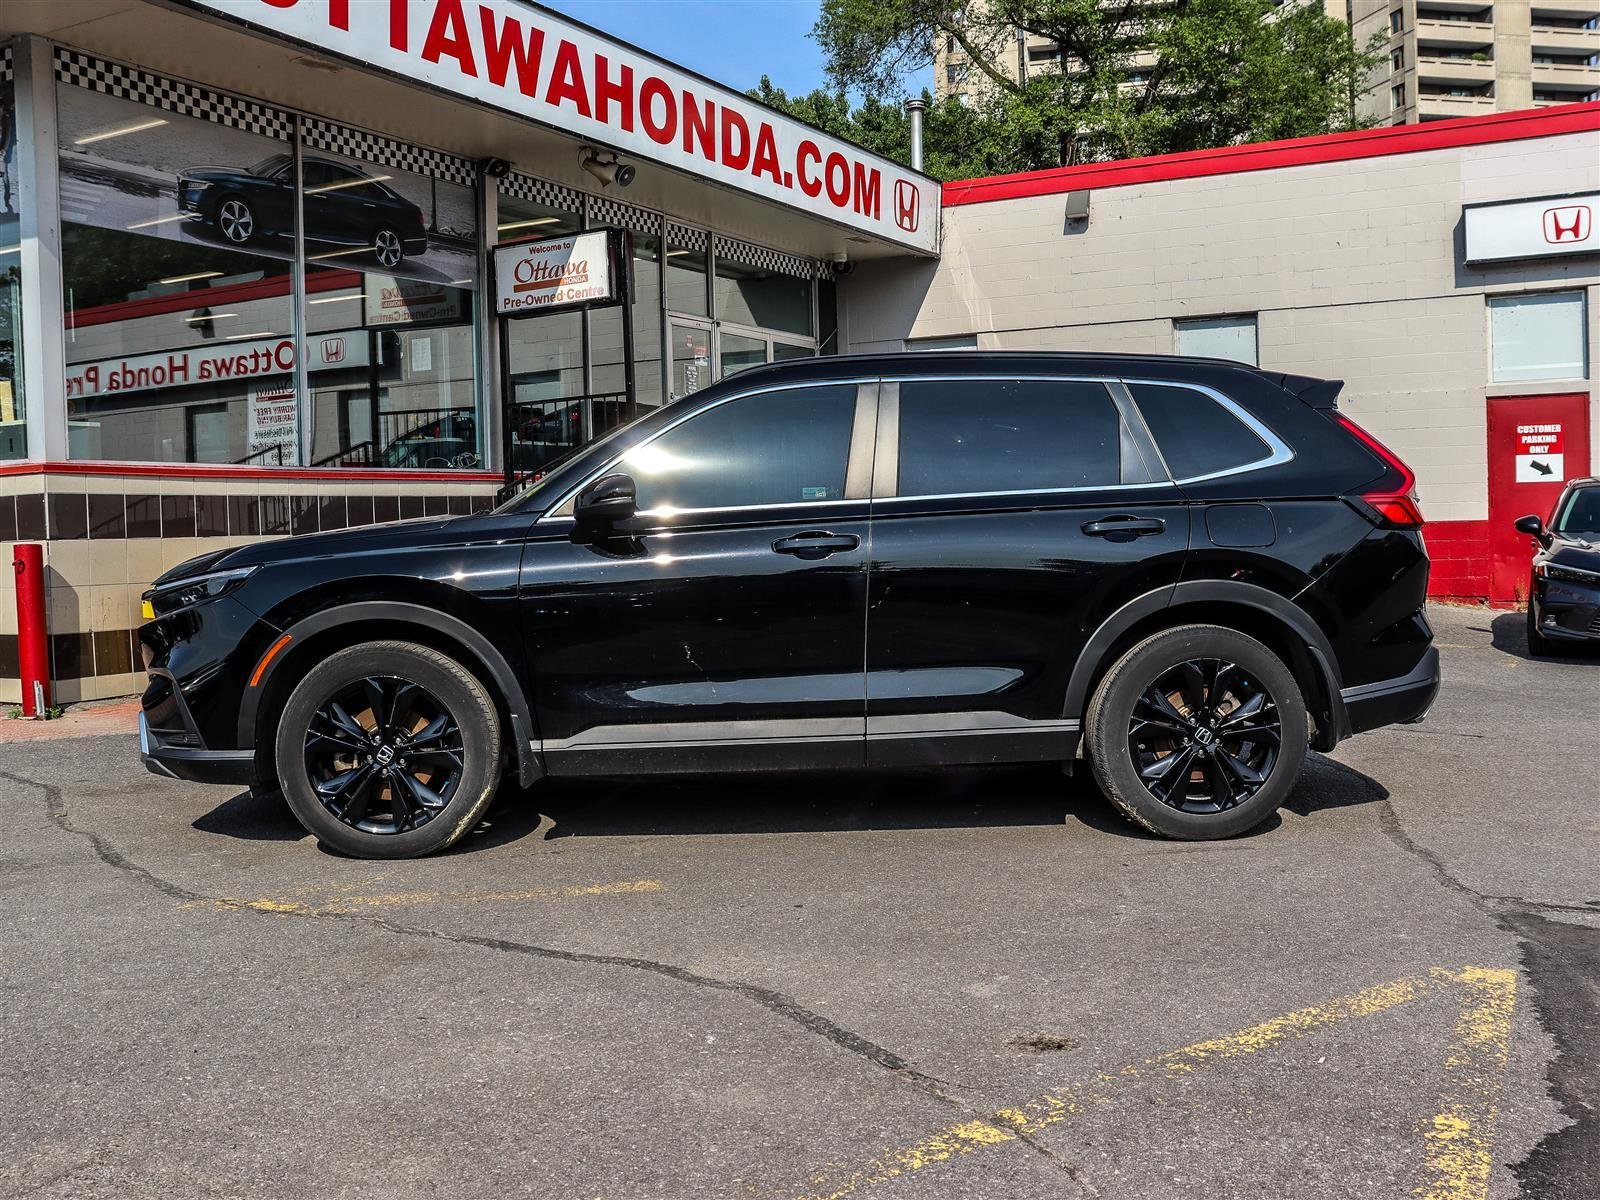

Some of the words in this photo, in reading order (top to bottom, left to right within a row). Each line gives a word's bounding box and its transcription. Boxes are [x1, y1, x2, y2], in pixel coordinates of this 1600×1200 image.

[260, 0, 881, 221] AWAHONDA.COM
[529, 243, 562, 255] Welcome
[562, 241, 571, 249] to
[514, 258, 588, 283] Ottawa
[564, 275, 587, 285] HONDA
[503, 292, 564, 309] Pre-Owned
[566, 286, 604, 300] Centre
[1517, 424, 1561, 434] CUSTOMER
[1521, 435, 1557, 444] PARKING
[1529, 445, 1549, 454] ONLY
